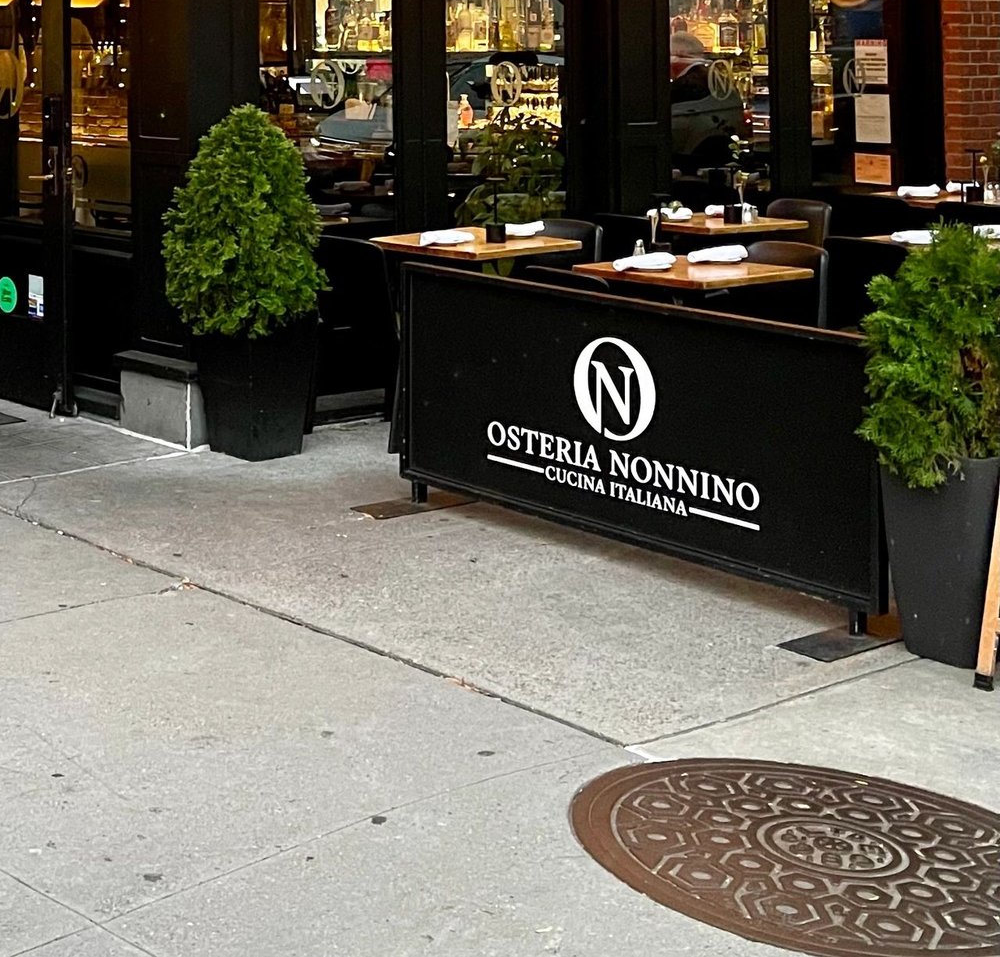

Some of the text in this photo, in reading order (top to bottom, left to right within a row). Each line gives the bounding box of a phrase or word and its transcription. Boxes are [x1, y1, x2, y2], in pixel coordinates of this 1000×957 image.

[487, 421, 760, 511] OSTERIA NONNINO
[545, 466, 688, 517] CUCINA ITALIANA
